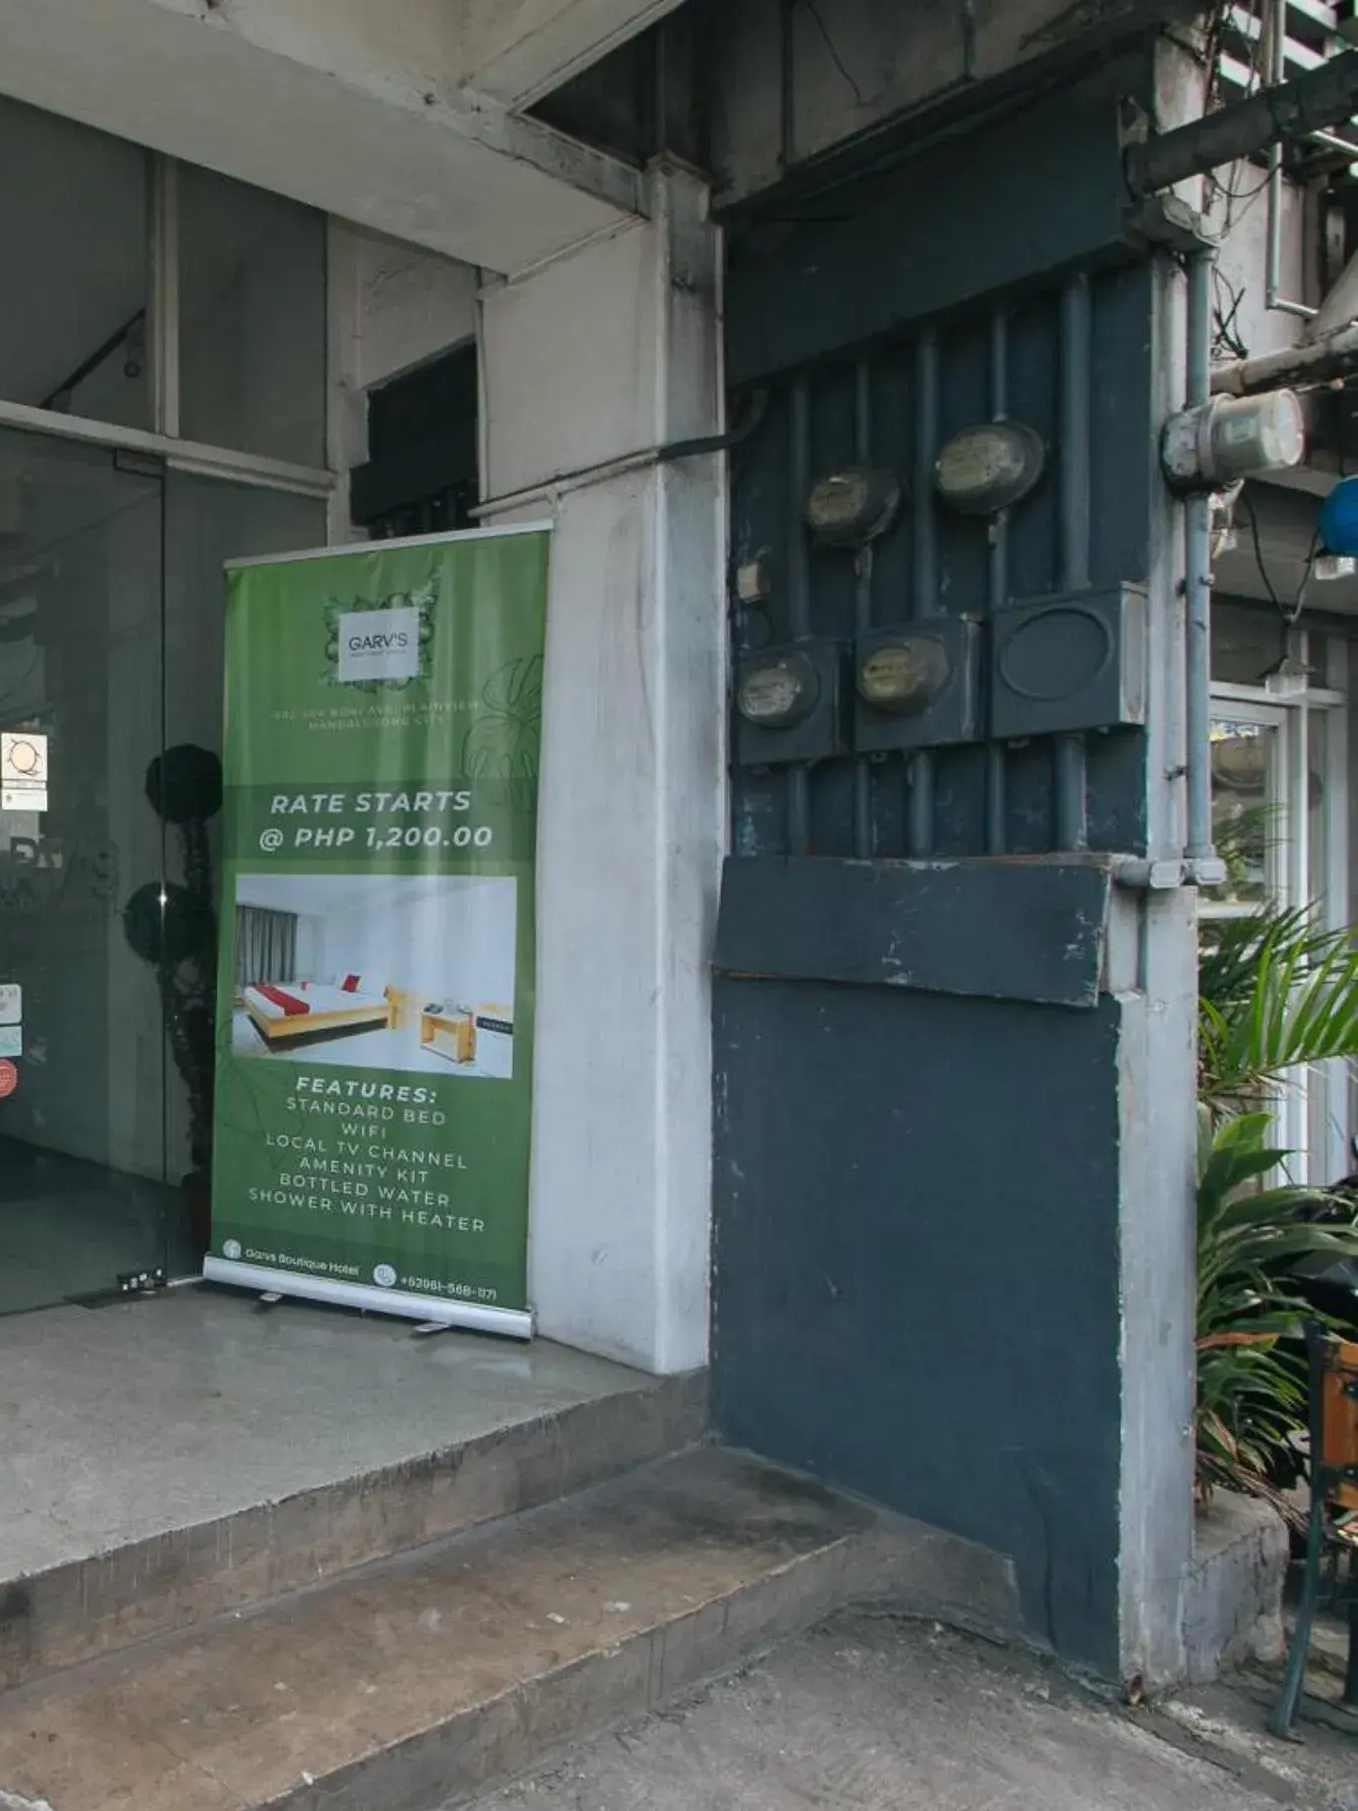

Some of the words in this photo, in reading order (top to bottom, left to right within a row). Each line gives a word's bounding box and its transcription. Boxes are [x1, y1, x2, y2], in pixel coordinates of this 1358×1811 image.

[348, 632, 409, 651] GARV'S
[270, 793, 346, 815] RATE
[353, 790, 472, 813] STARTS
[259, 827, 284, 852] @
[294, 826, 356, 848] PHP
[366, 825, 493, 850] 1,200.00
[295, 1076, 438, 1105] FEATURES:
[286, 1096, 394, 1120] STANDARD
[403, 1109, 446, 1126] BED
[341, 1122, 387, 1139] WIFI
[266, 1133, 327, 1152] LOCAL
[337, 1140, 360, 1156] TV
[368, 1145, 468, 1170] CHANNEL
[299, 1156, 388, 1180] AMENITY
[397, 1168, 429, 1184] KIT
[279, 1173, 369, 1197] BOTTLED
[378, 1186, 450, 1208] WATER
[248, 1187, 332, 1211] SHOWER
[341, 1201, 392, 1220] WITH
[401, 1210, 485, 1233] HEATER
